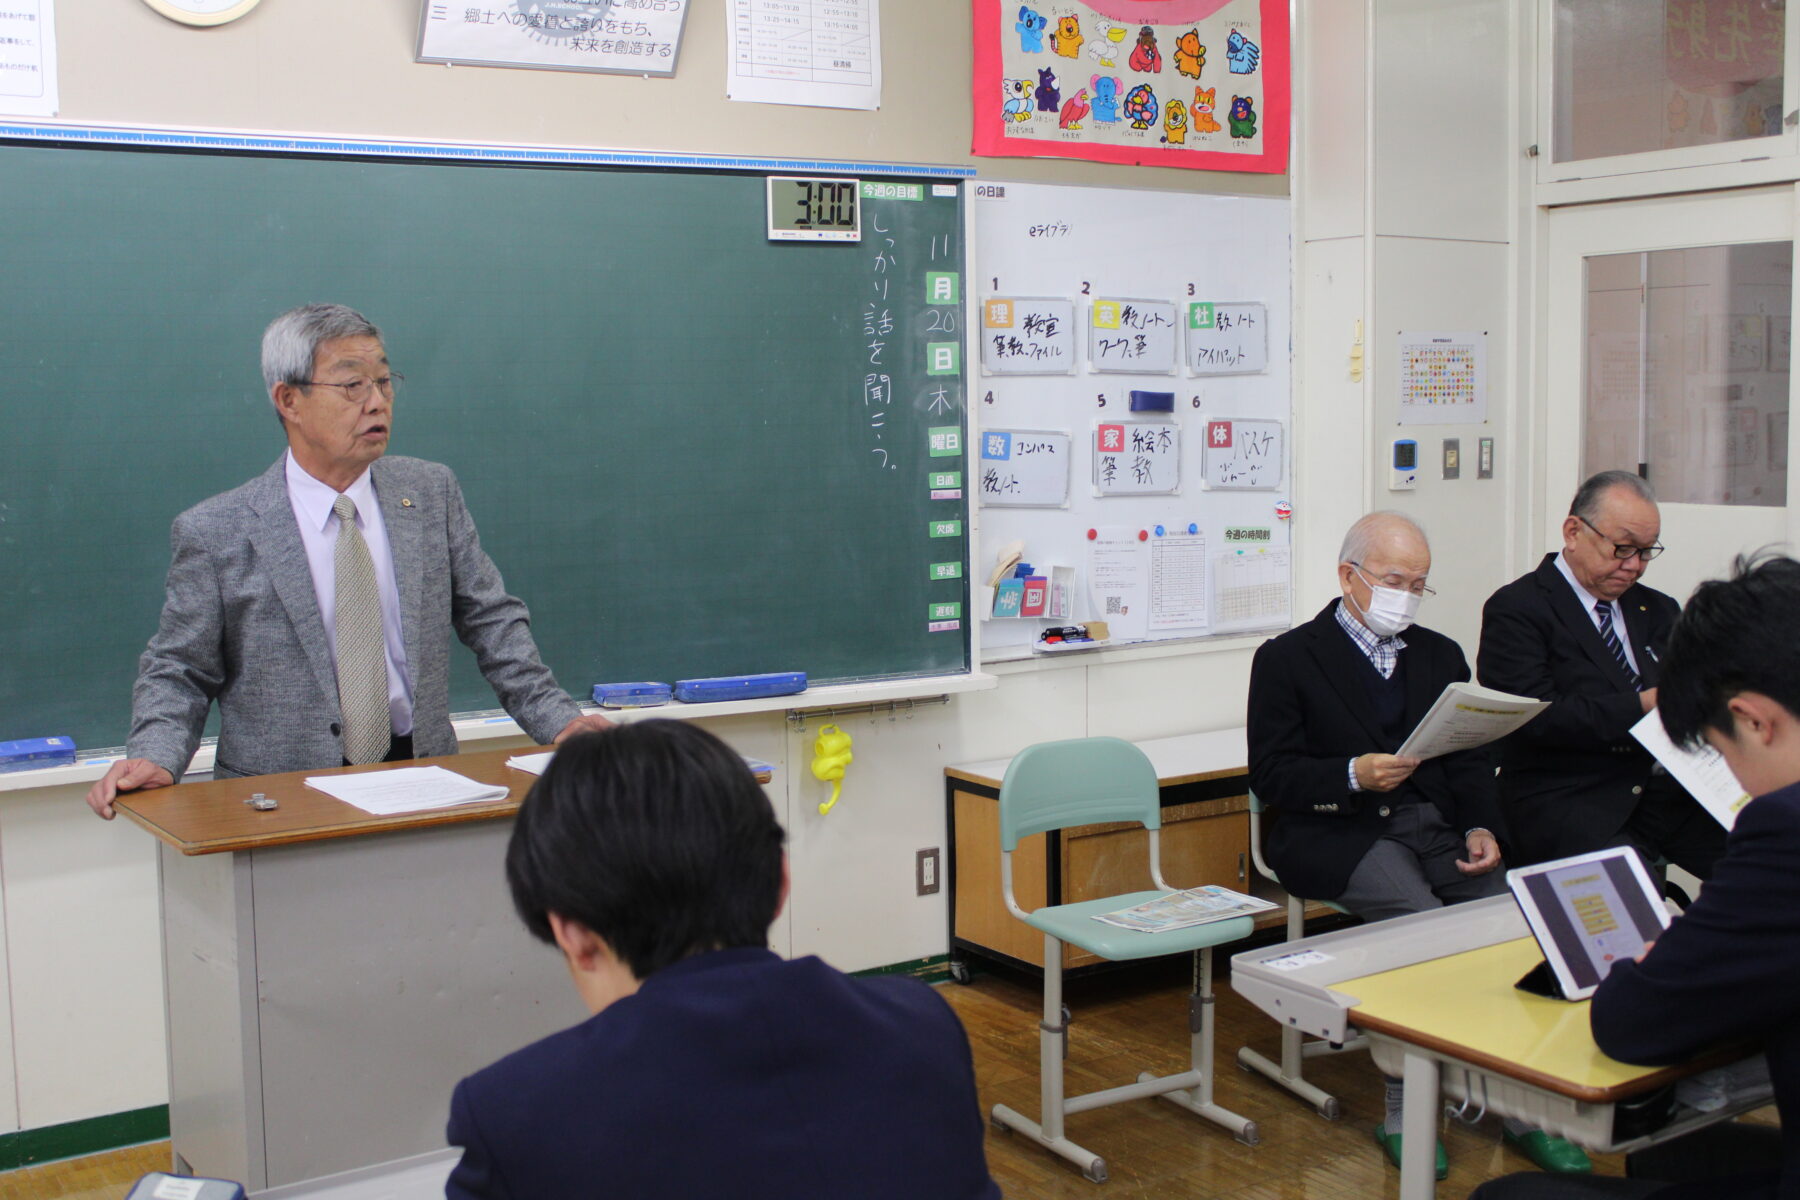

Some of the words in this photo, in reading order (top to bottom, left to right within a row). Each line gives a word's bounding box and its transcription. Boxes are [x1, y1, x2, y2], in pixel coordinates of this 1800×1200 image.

[464, 8, 652, 36] 郷土への愛着と誇りをもち、
[570, 37, 672, 58] 未来を創造する
[863, 183, 918, 199] 今週の目標
[974, 186, 1005, 198] の日課
[794, 181, 855, 226] 3:00
[934, 277, 953, 300] 月
[992, 276, 999, 291] 1
[1081, 281, 1091, 295] 2
[1187, 283, 1195, 296] 3
[926, 309, 955, 333] 20
[991, 303, 1009, 324] 理
[1098, 305, 1114, 324] 英
[1194, 305, 1210, 325] 社
[935, 347, 953, 370] 日
[927, 384, 952, 416] 木
[984, 391, 994, 404] 4
[1097, 394, 1107, 407] 5
[1192, 395, 1201, 408] 6
[931, 433, 958, 450] 曜日
[1103, 429, 1120, 448] 家
[1132, 427, 1172, 454] 絵本
[1212, 425, 1227, 445] 体
[988, 434, 1005, 456] 数
[1233, 430, 1274, 460] バスケ
[936, 475, 955, 486] 日直
[936, 524, 955, 535] 欠席
[1225, 529, 1271, 541] 今週の時間割
[936, 565, 956, 577] 早退
[935, 606, 955, 617] 遅刻
